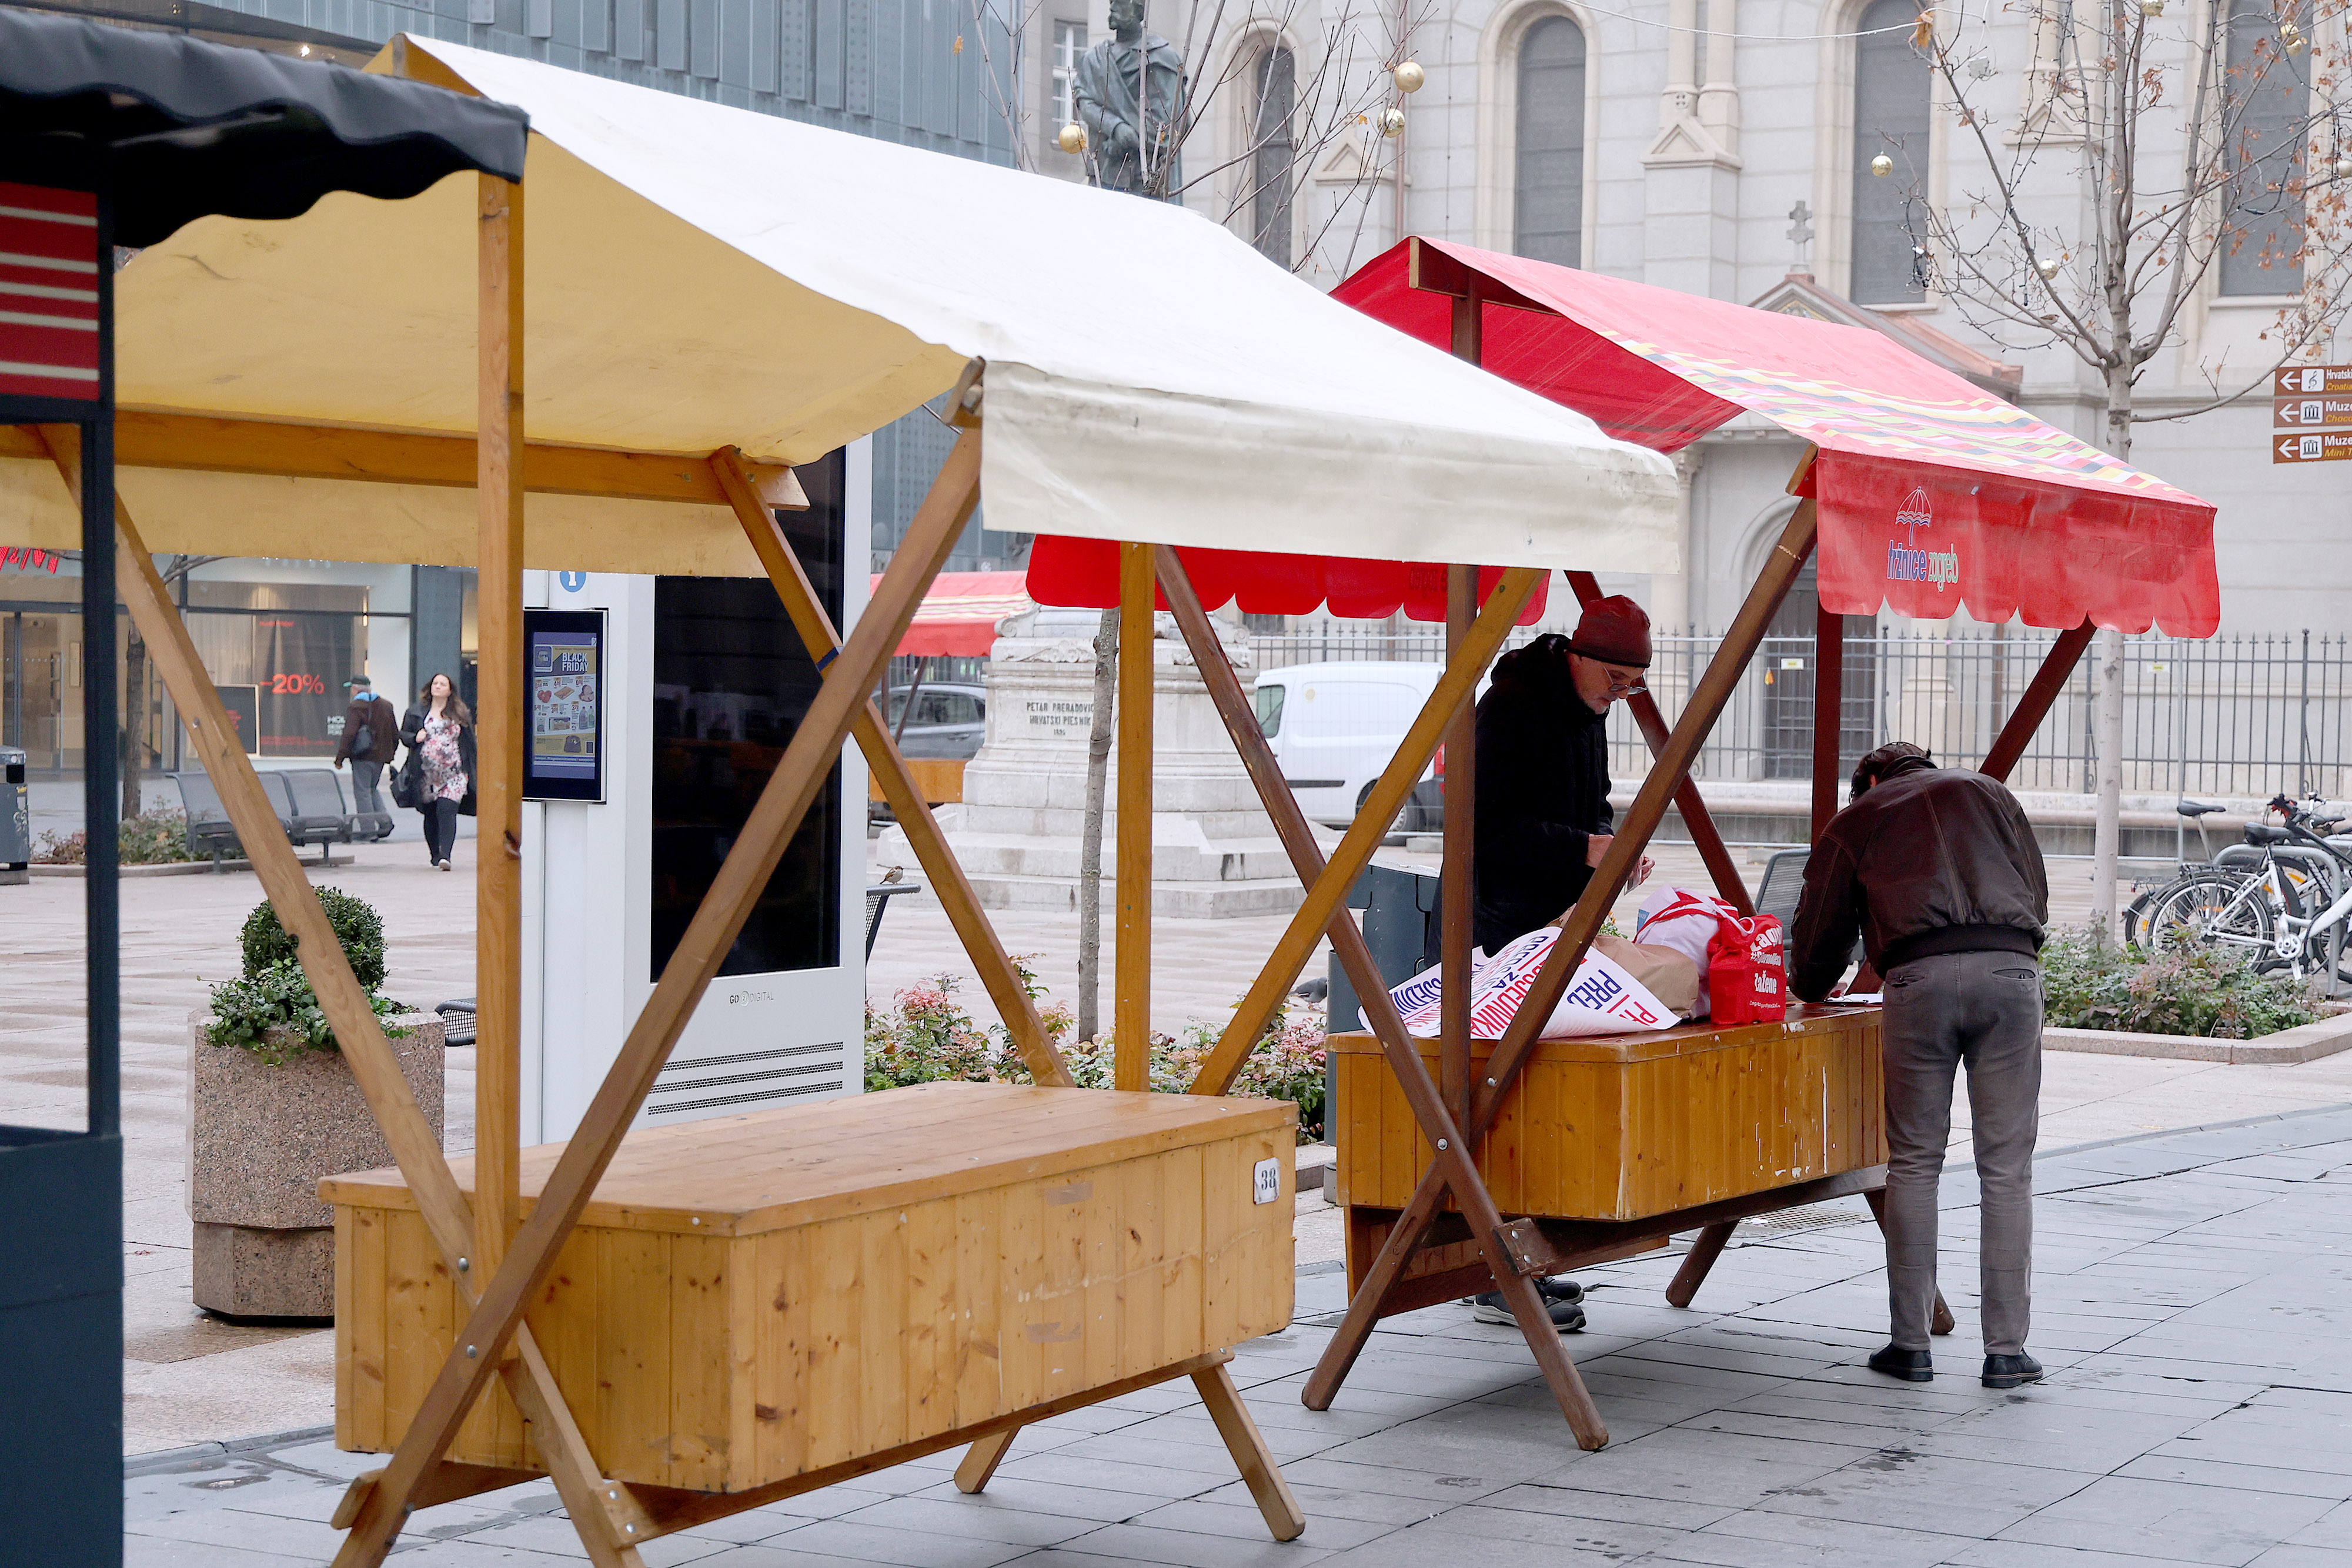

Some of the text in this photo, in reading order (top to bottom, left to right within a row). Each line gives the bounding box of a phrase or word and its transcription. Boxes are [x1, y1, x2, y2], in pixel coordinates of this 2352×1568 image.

[2324, 448, 2344, 457] Mini
[1887, 540, 1959, 592] tržnice zagreb
[562, 652, 587, 662] BLACK
[562, 662, 589, 672] FRIDAY
[259, 673, 325, 694] -20%
[1027, 702, 1048, 711] PETAR
[1030, 715, 1061, 725] HRVATSKI
[1492, 971, 1519, 989] ZA
[730, 994, 739, 1004] GO
[1261, 1168, 1276, 1191] 38
